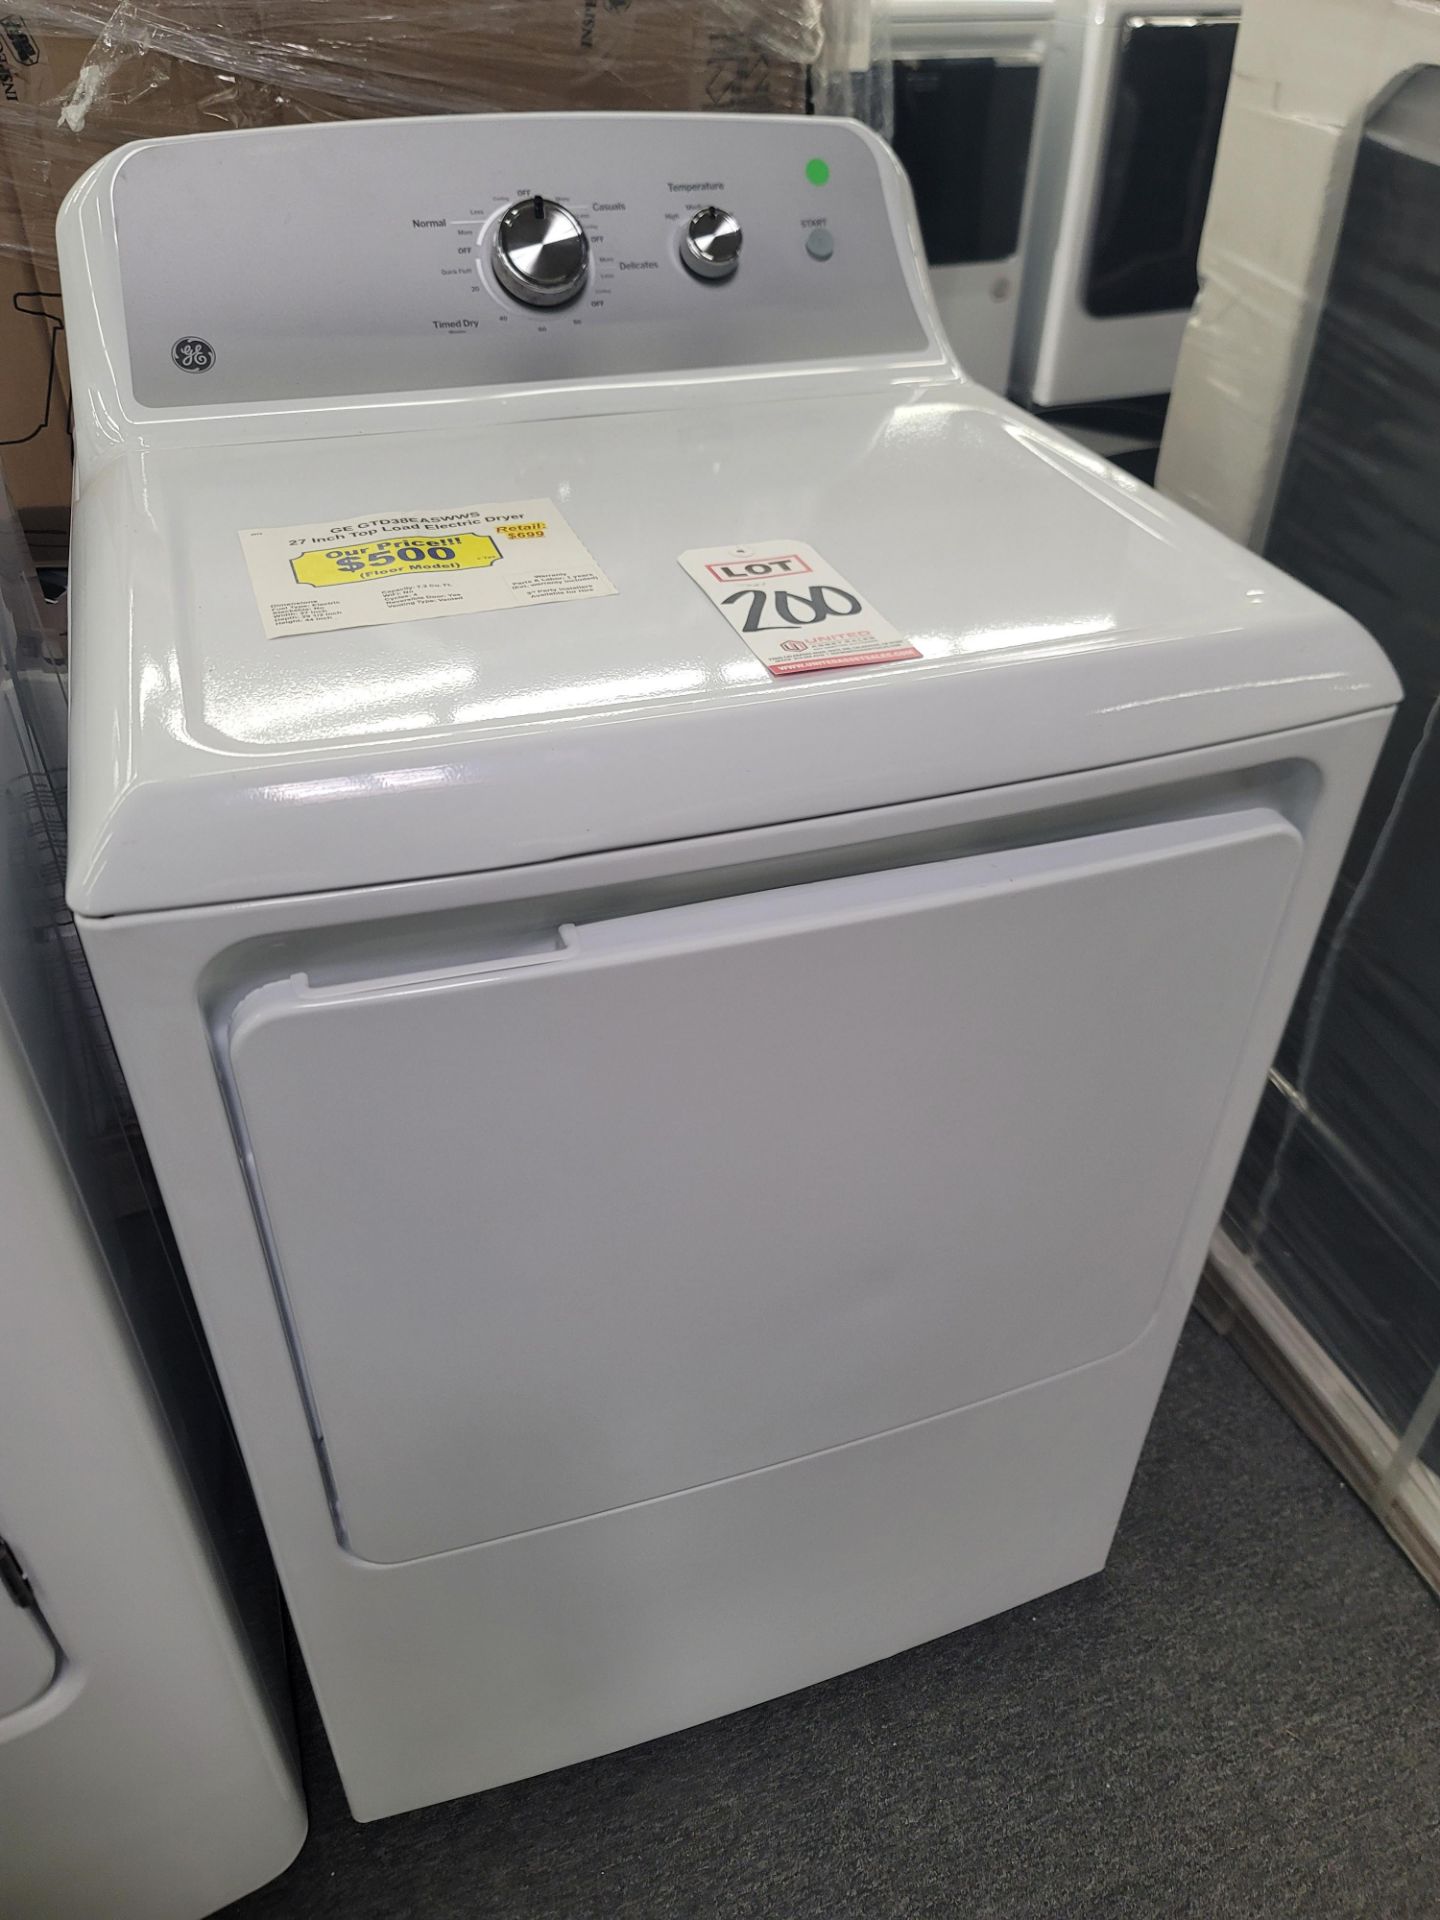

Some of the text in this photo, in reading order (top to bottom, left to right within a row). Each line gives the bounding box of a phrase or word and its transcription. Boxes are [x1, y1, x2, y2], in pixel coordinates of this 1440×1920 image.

[667, 182, 724, 192] Temperature
[592, 202, 626, 211] Casuals
[412, 218, 447, 229] Normal
[801, 218, 827, 228] START
[619, 261, 659, 271] Delicates
[432, 319, 480, 329] Timed Dry
[288, 513, 525, 546] 27 Inch Top Load Electric Dryer
[330, 525, 354, 534] GE
[496, 522, 547, 534] Retail:
[507, 530, 545, 540] $699
[325, 537, 463, 559] Our Price!!!
[335, 546, 456, 573] $500
[359, 562, 461, 579] (Floor Model)
[720, 559, 793, 578] LOT
[720, 585, 863, 633] 200
[803, 630, 871, 645] UNITED
